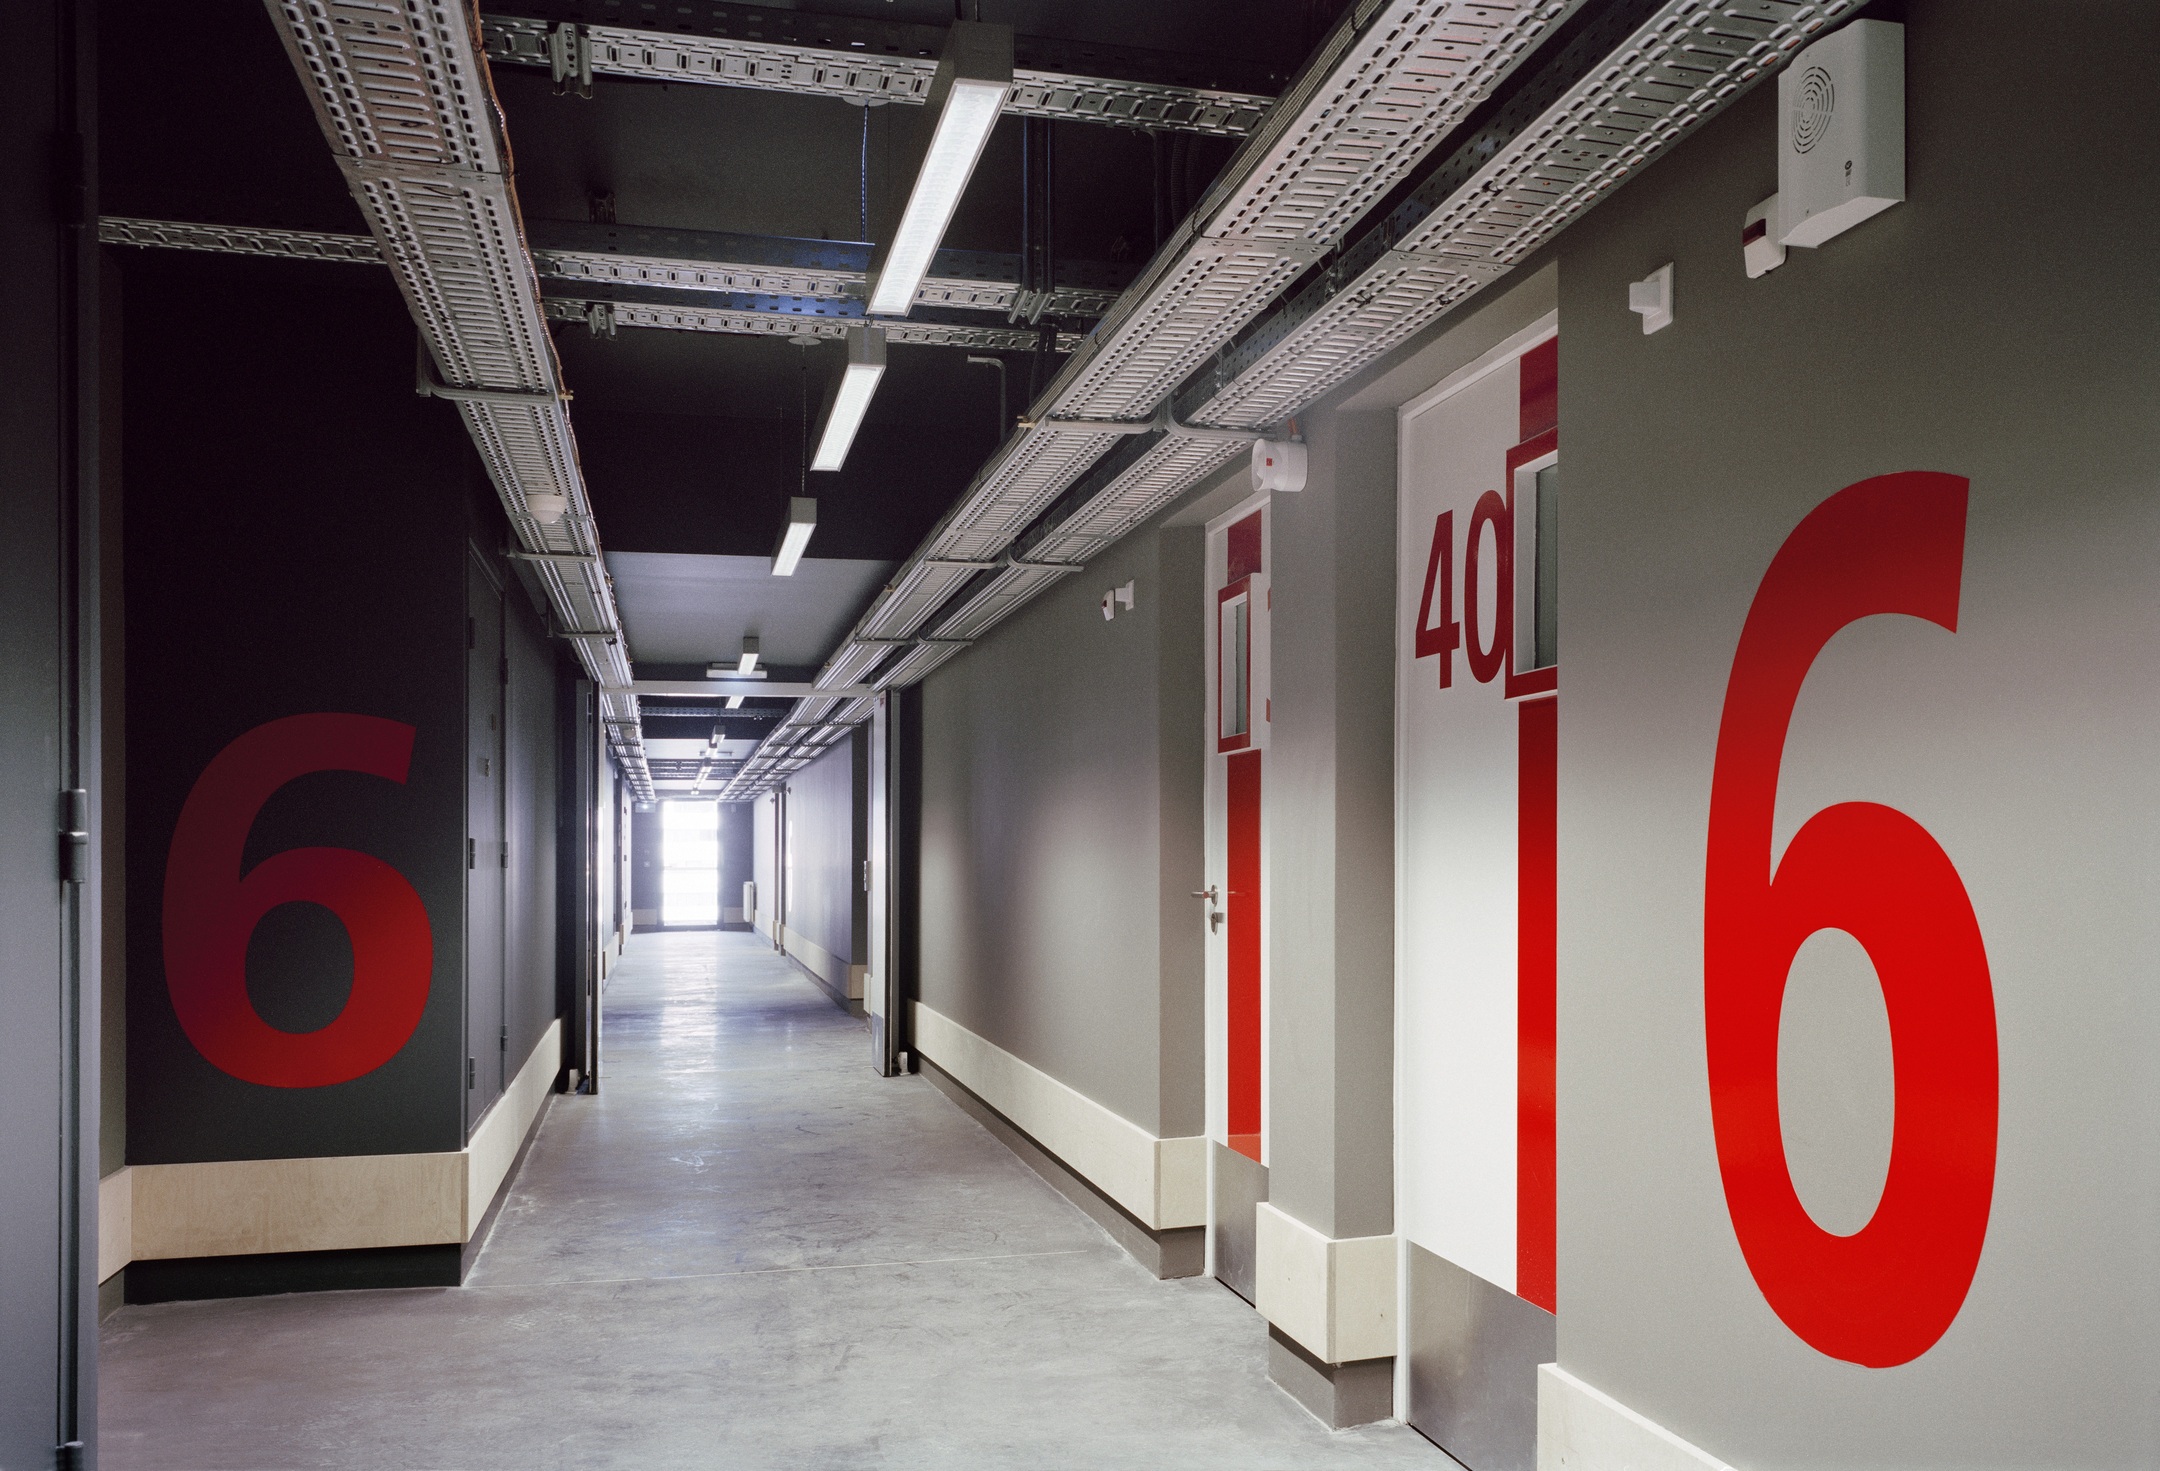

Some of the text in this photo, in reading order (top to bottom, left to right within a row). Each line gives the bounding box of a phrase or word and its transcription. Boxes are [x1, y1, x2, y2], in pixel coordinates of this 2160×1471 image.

[1415, 489, 1510, 690] 40
[162, 711, 434, 1090] 6
[1704, 470, 1999, 1369] 6
